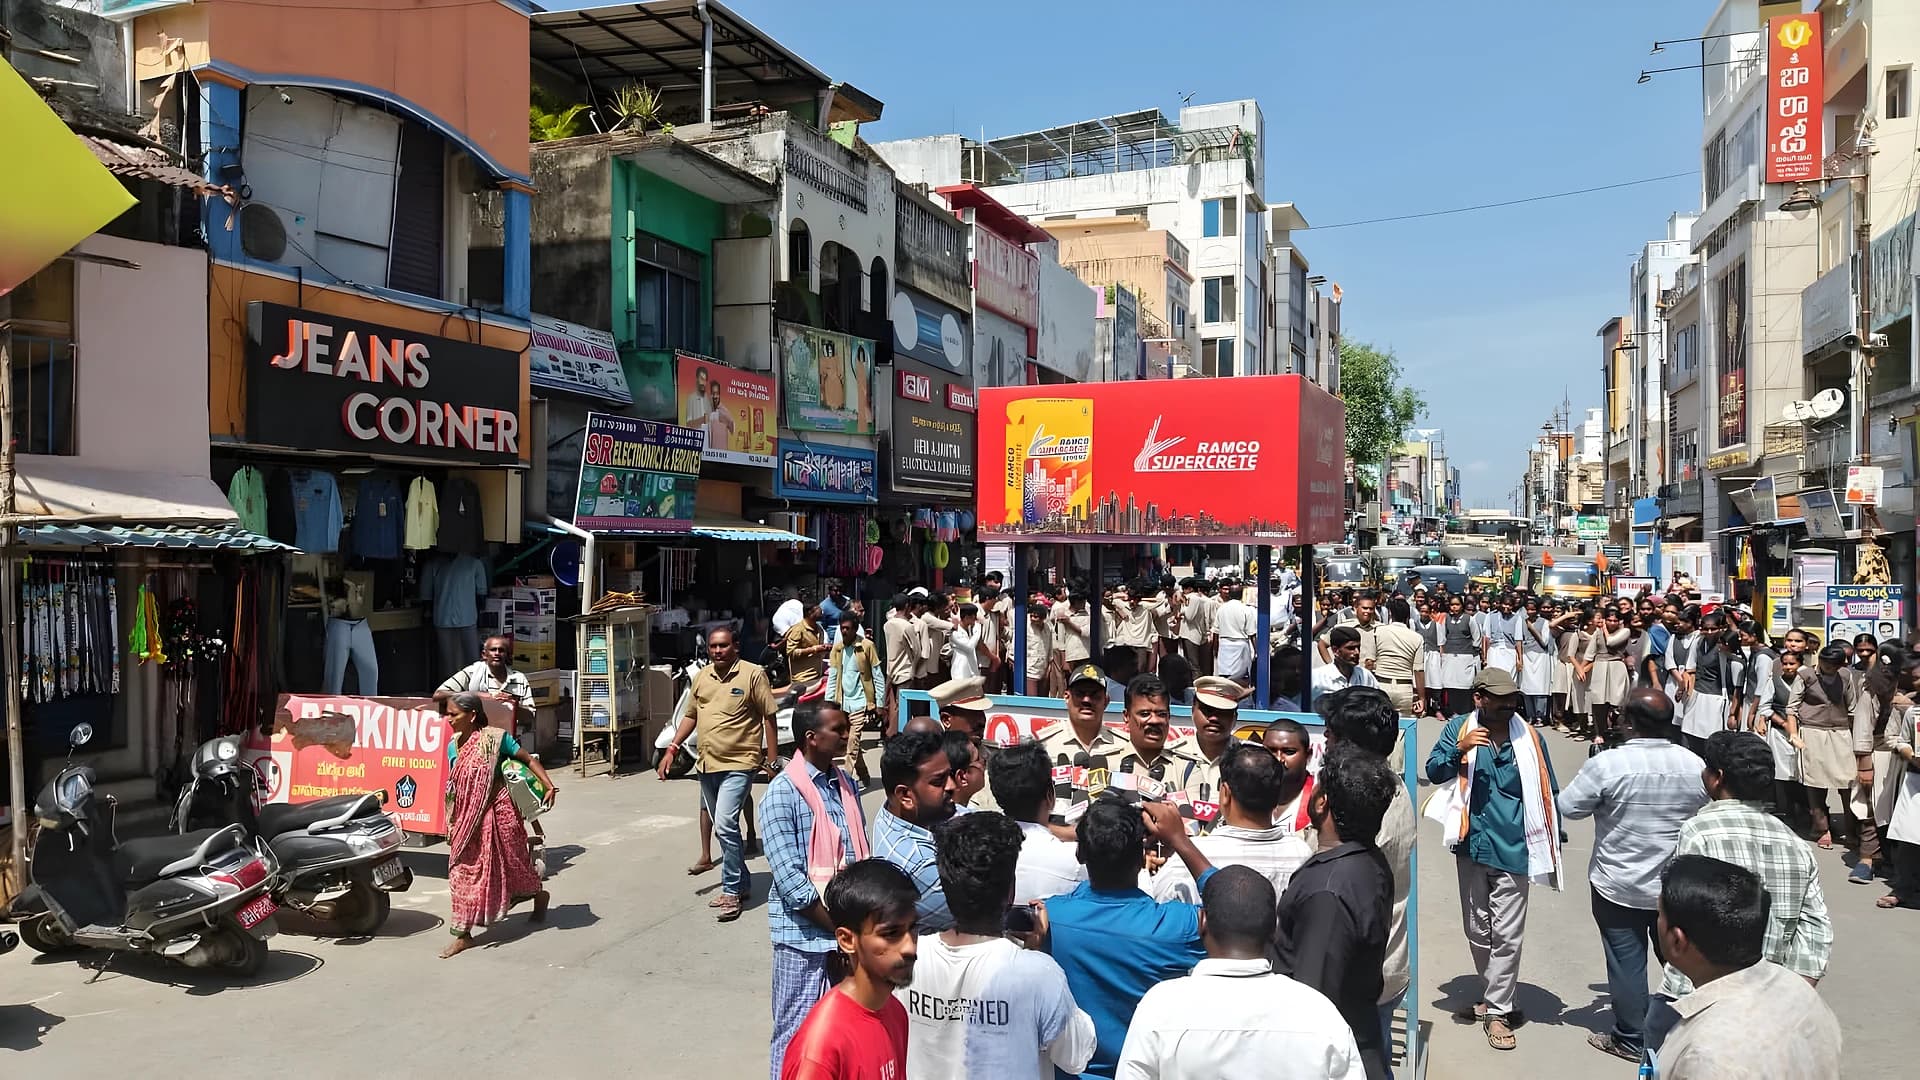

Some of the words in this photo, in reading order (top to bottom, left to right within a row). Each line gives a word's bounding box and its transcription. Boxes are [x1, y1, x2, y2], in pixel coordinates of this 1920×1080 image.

[270, 319, 430, 388] JEANS
[341, 392, 518, 453] CORNER
[586, 433, 613, 465] SR
[1151, 455, 1258, 470] SUPERCRETE
[1198, 441, 1260, 454] RAMCO
